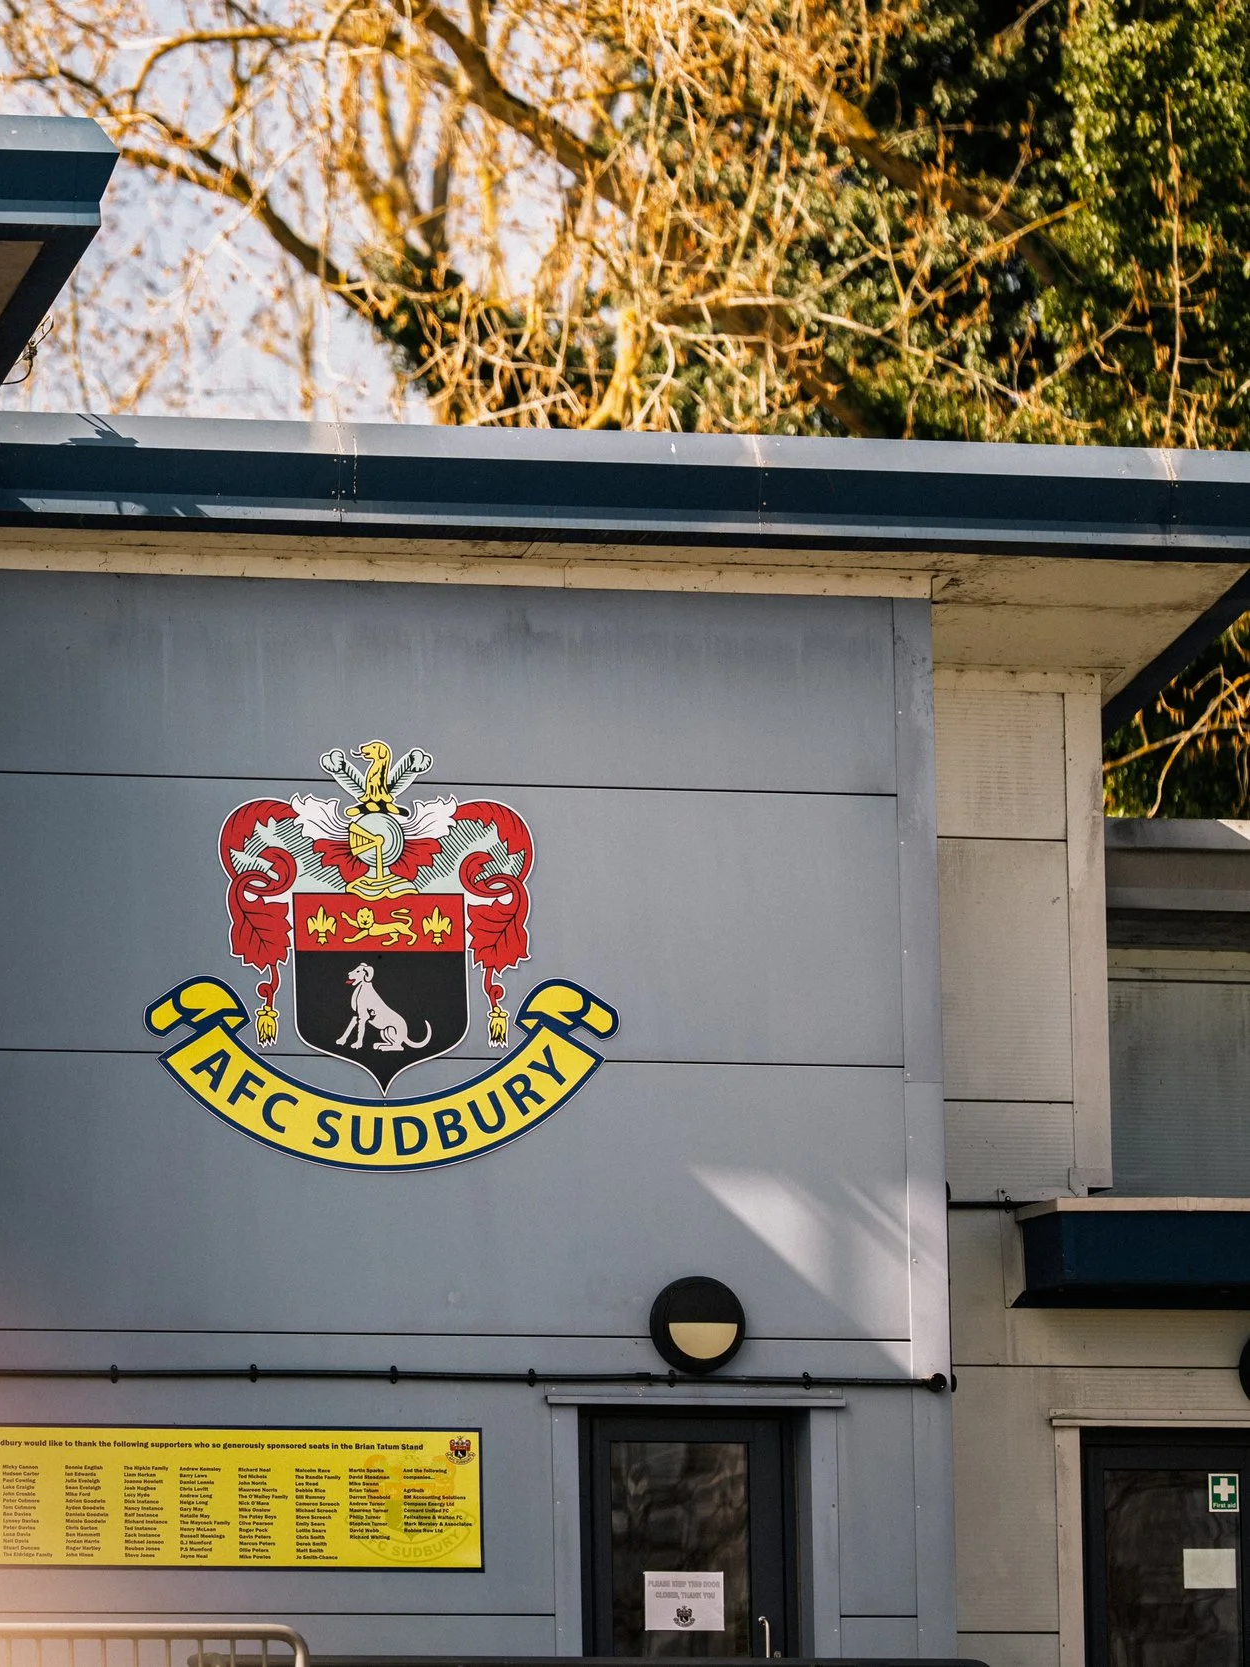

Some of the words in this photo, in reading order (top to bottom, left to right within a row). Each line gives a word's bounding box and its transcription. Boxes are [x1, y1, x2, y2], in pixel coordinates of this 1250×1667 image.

[191, 1048, 300, 1133] AFC
[311, 1044, 569, 1156] SUDBURY
[392, 1529, 460, 1558] SUDBURY
